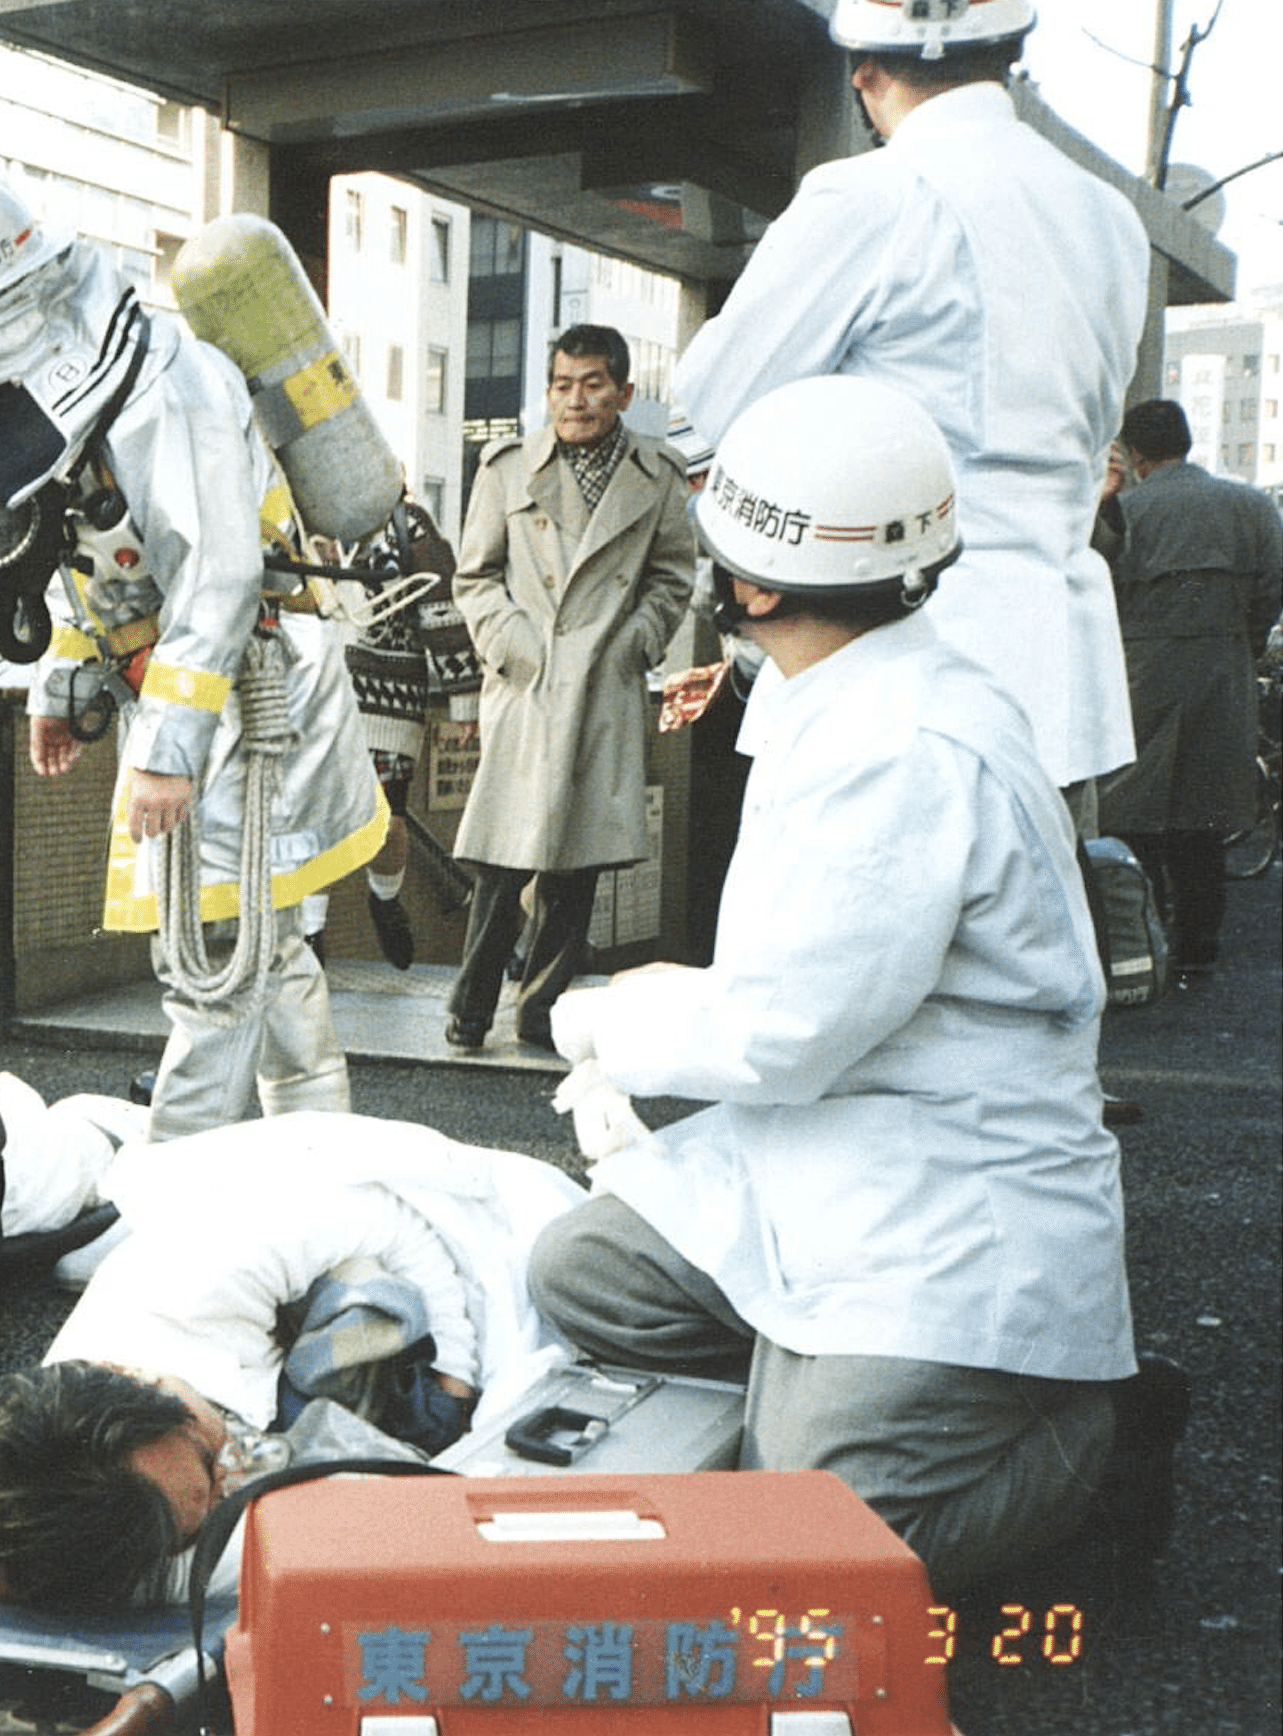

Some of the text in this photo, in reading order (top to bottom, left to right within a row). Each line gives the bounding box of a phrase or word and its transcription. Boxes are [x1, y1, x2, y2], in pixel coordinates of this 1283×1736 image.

[710, 463, 812, 546] 東京消防庁
[357, 1624, 844, 1705] 東京消防庁
